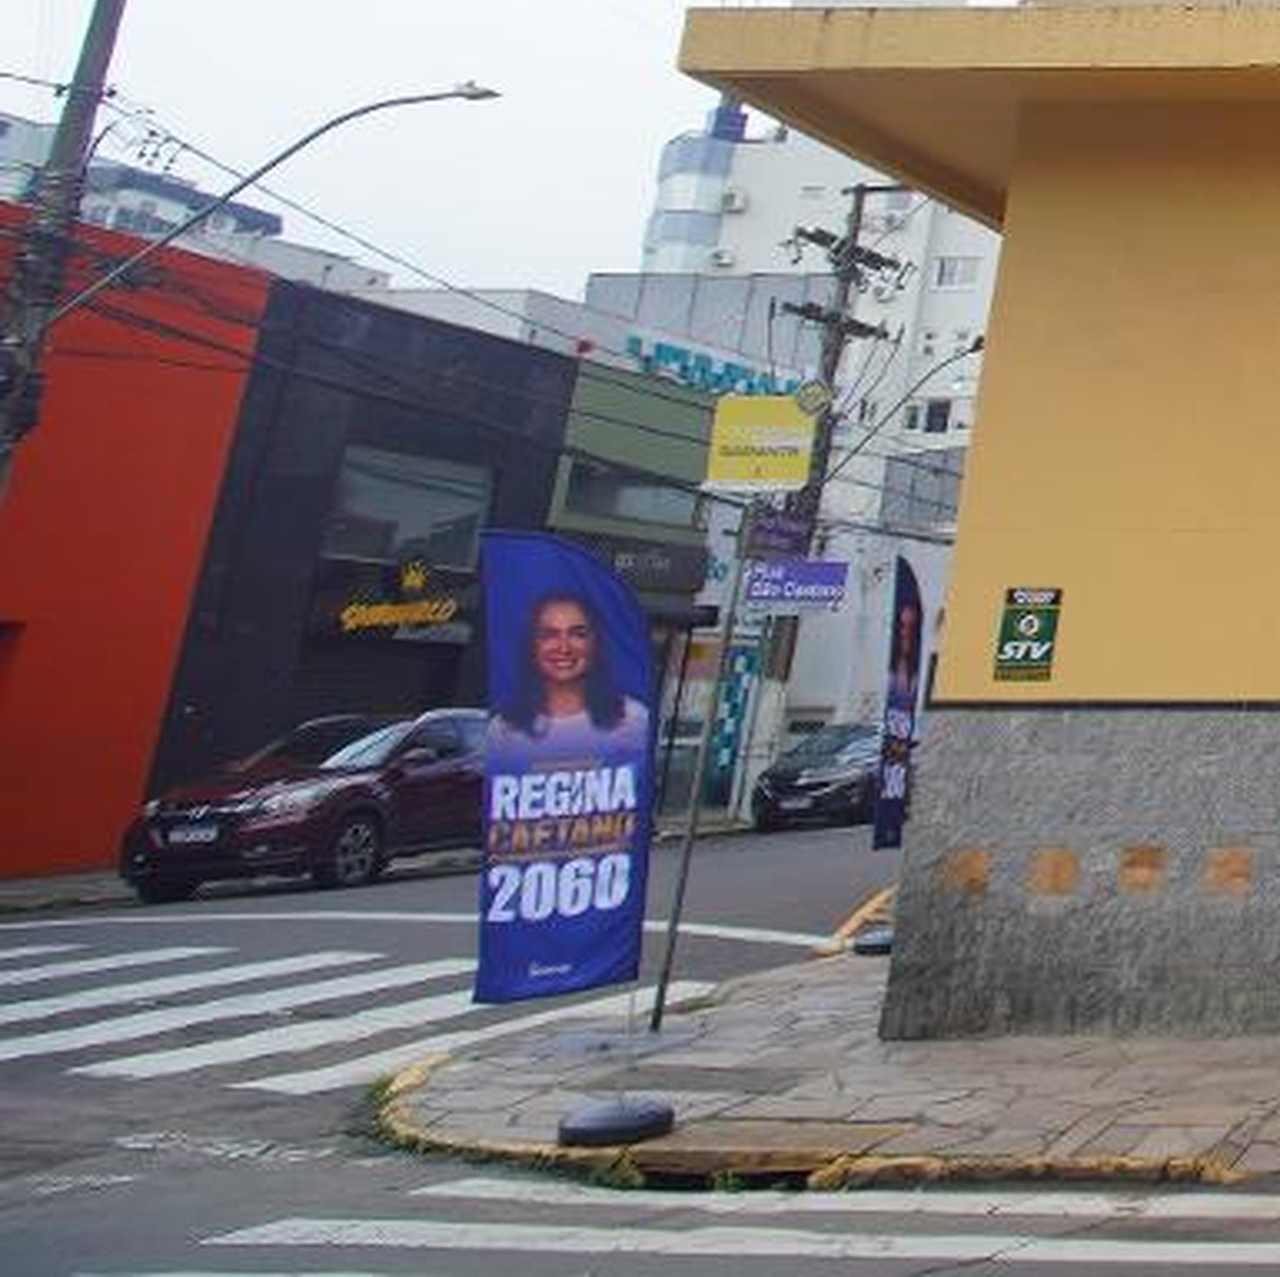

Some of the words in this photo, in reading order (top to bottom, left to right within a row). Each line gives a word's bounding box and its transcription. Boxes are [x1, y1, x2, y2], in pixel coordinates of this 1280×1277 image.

[997, 641, 1053, 660] STV
[490, 764, 637, 821] REGINA
[487, 853, 630, 924] 2060
